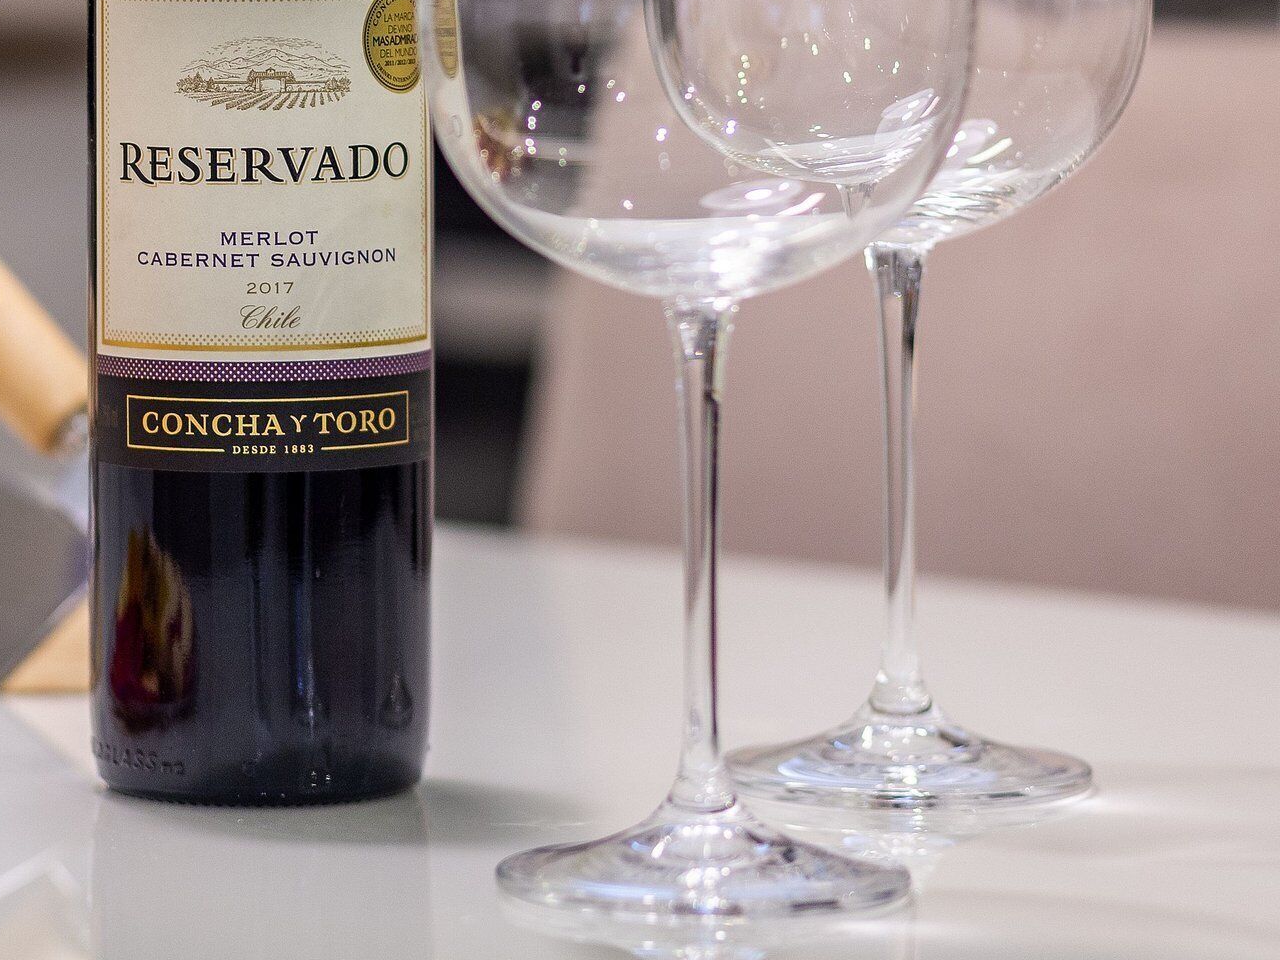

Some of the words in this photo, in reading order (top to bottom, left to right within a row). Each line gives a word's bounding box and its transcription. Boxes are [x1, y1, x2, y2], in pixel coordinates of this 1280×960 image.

[383, 13, 393, 23] LA
[119, 141, 409, 186] RESERVADO
[220, 230, 319, 247] MERLOT
[137, 251, 260, 268] CABERNET
[270, 246, 397, 268] SAUVIGNON
[246, 281, 294, 295] 2017
[239, 304, 302, 330] Chile
[142, 411, 286, 437] CONCHA
[289, 414, 308, 433] Y
[313, 407, 396, 435] TORO
[232, 444, 277, 455] DESDE
[284, 443, 315, 454] 1883
